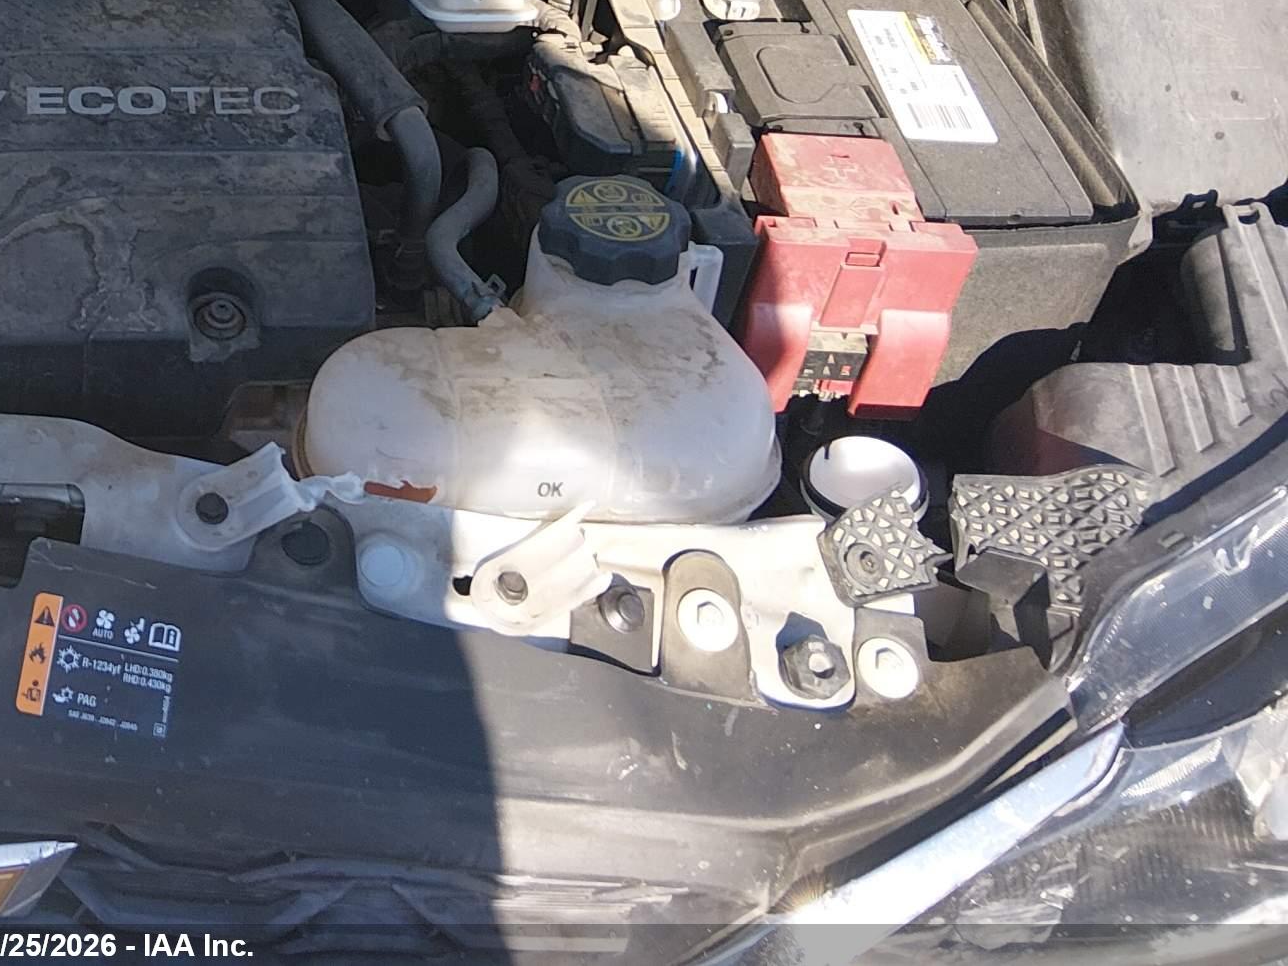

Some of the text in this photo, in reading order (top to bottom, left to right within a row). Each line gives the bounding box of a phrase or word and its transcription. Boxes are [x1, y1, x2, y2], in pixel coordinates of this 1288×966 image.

[26, 86, 301, 115] ECOTEC
[537, 481, 564, 498] OK
[92, 627, 114, 640] AUTO
[82, 657, 121, 676] R-1234yf
[77, 692, 97, 707] PAG
